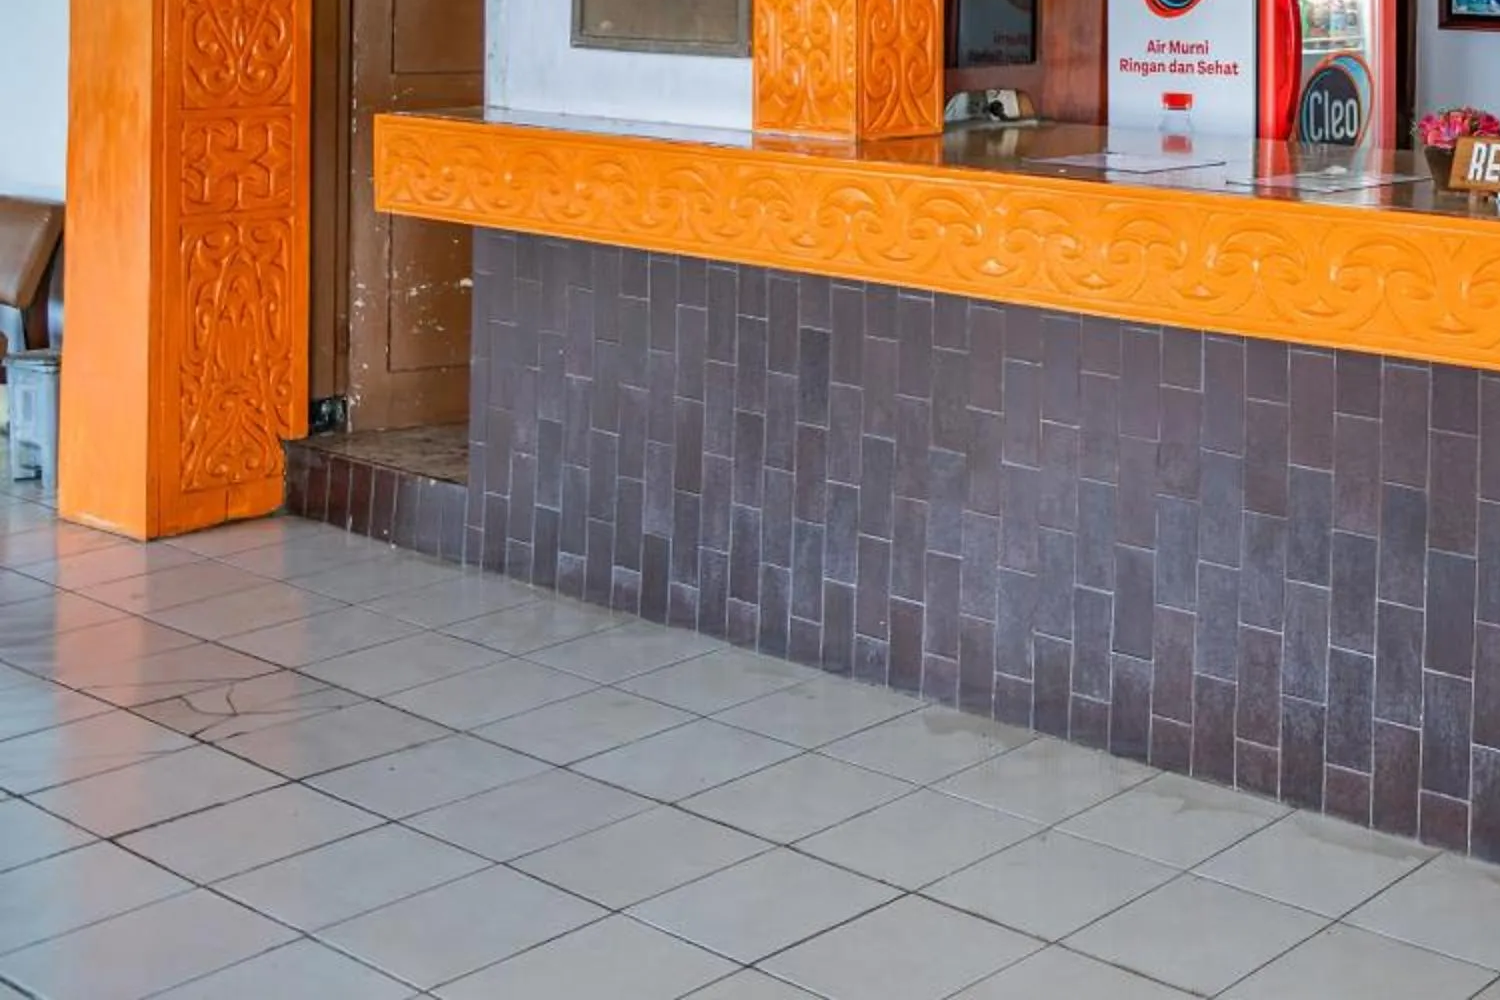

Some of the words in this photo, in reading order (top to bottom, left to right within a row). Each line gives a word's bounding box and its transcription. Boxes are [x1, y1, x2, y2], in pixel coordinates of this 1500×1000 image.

[1147, 39, 1166, 54] Air
[1169, 39, 1209, 55] Murni
[1119, 57, 1165, 77] Ringan
[1169, 58, 1194, 74] dan
[1197, 59, 1239, 75] Sehat
[1309, 89, 1359, 142] Cleo
